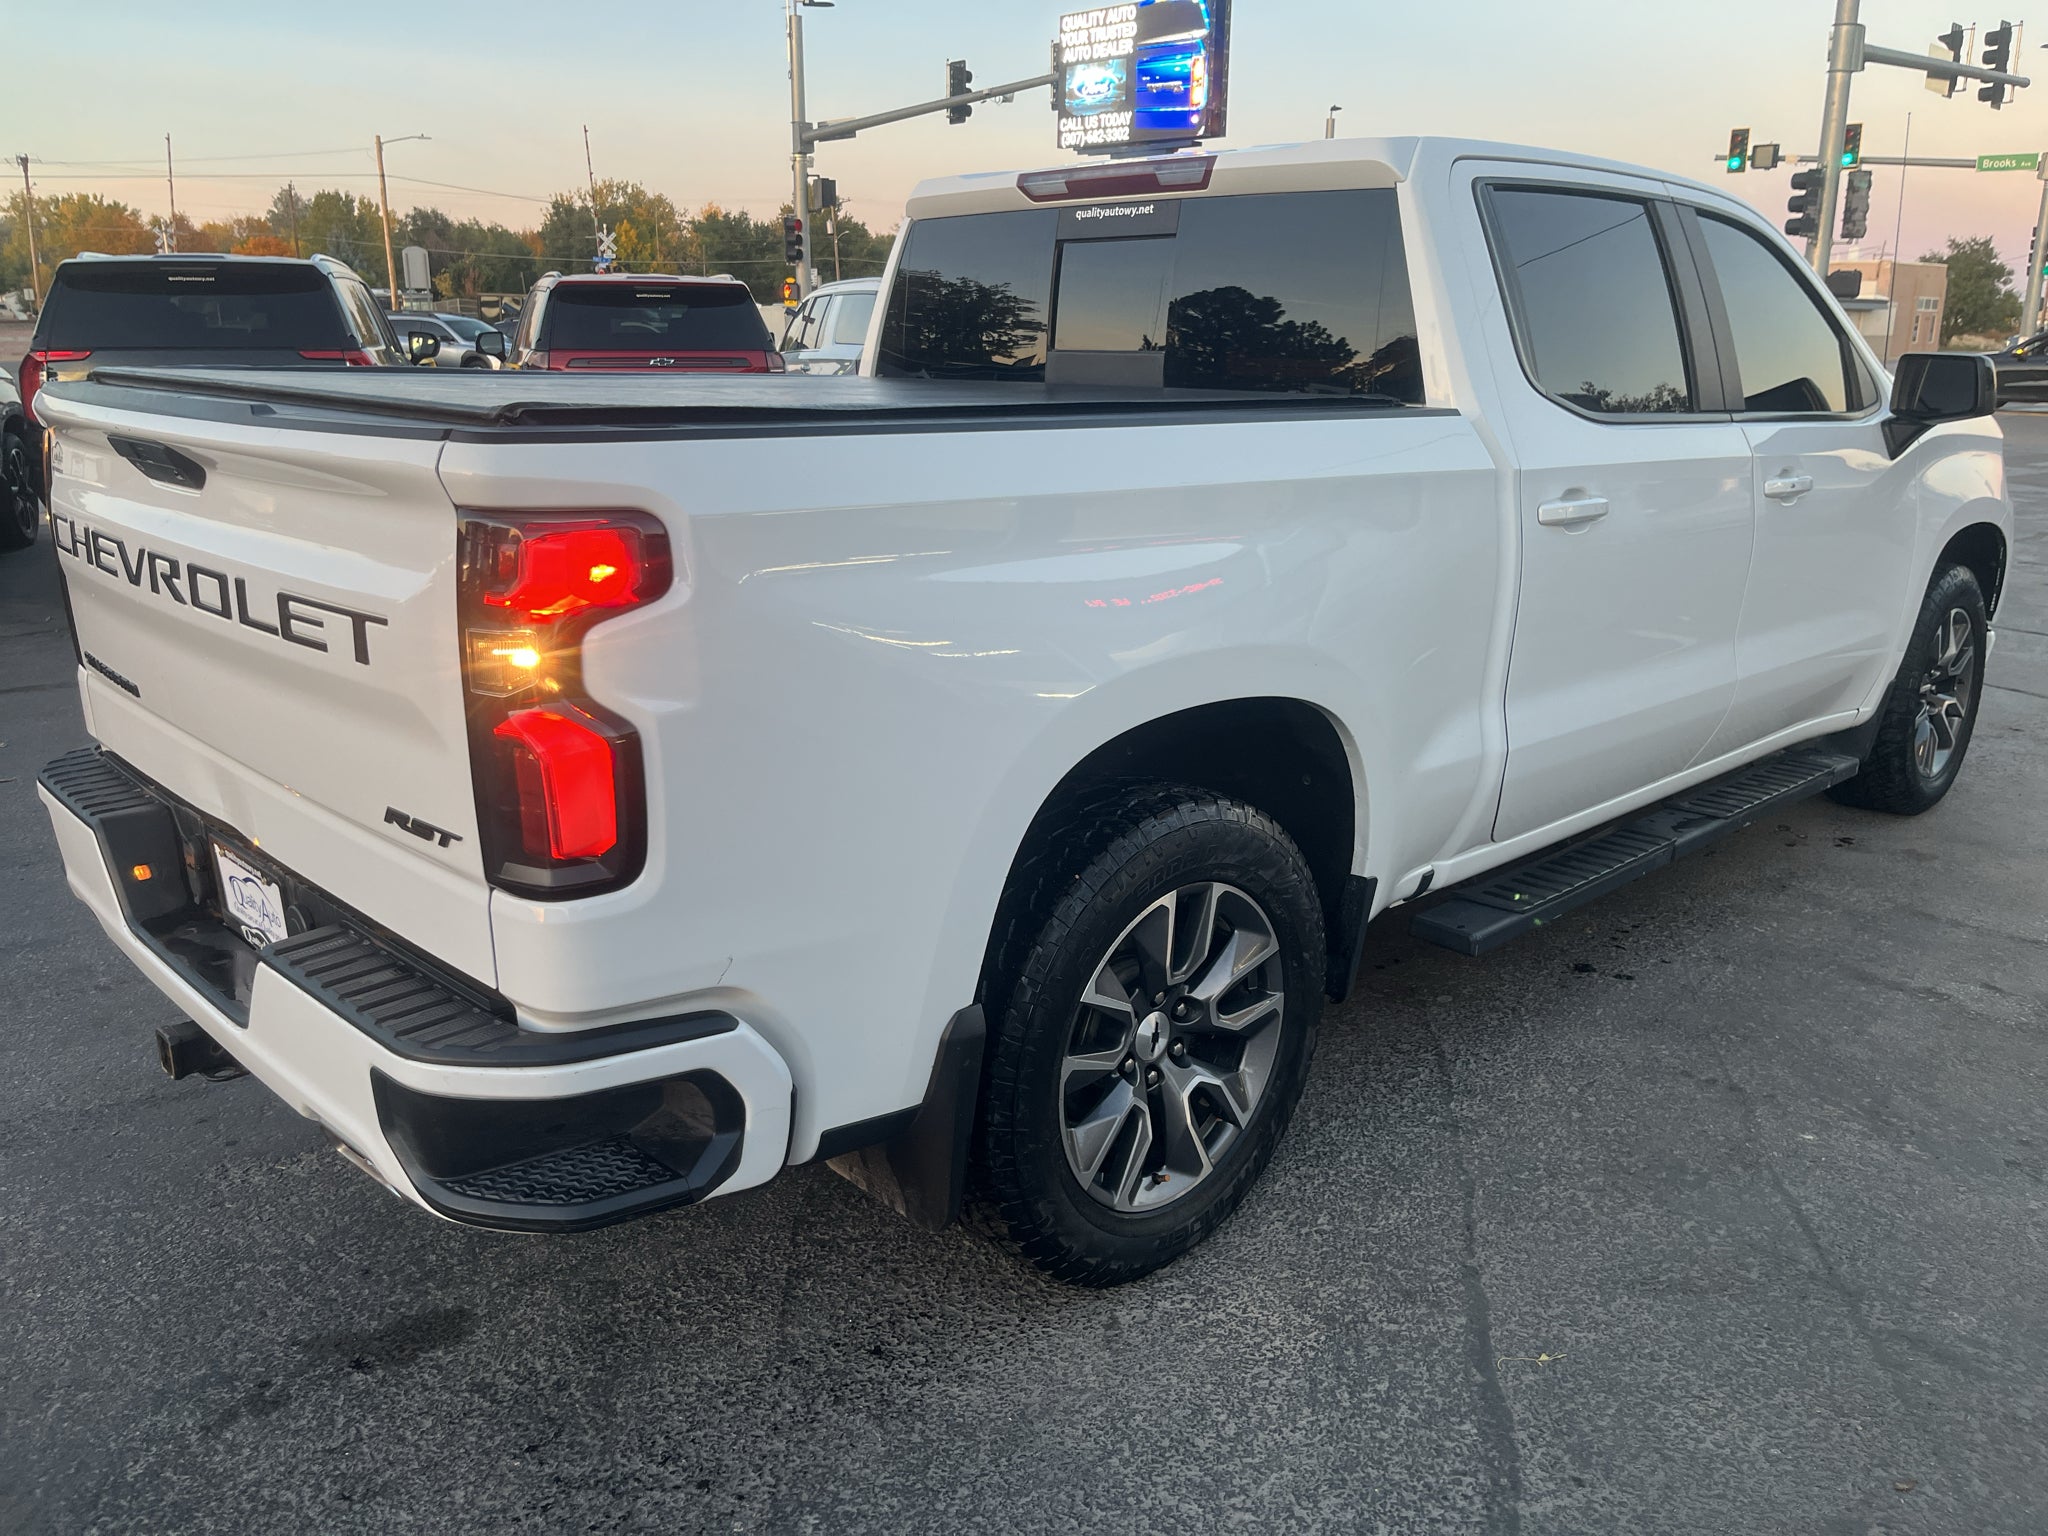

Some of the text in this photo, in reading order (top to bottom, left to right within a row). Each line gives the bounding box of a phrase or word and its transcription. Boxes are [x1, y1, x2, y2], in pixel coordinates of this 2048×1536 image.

[1062, 5, 1137, 31] QUALITY AUTO
[1061, 22, 1137, 48] YOUR TRUSTED
[1063, 46, 1092, 63] AUTO
[1060, 111, 1132, 132] CALL US TODAY
[1983, 159, 2016, 168] Brooks
[1076, 204, 1154, 220] qualityautowy.net
[53, 513, 388, 666] CHEVROLET
[384, 806, 463, 848] RST
